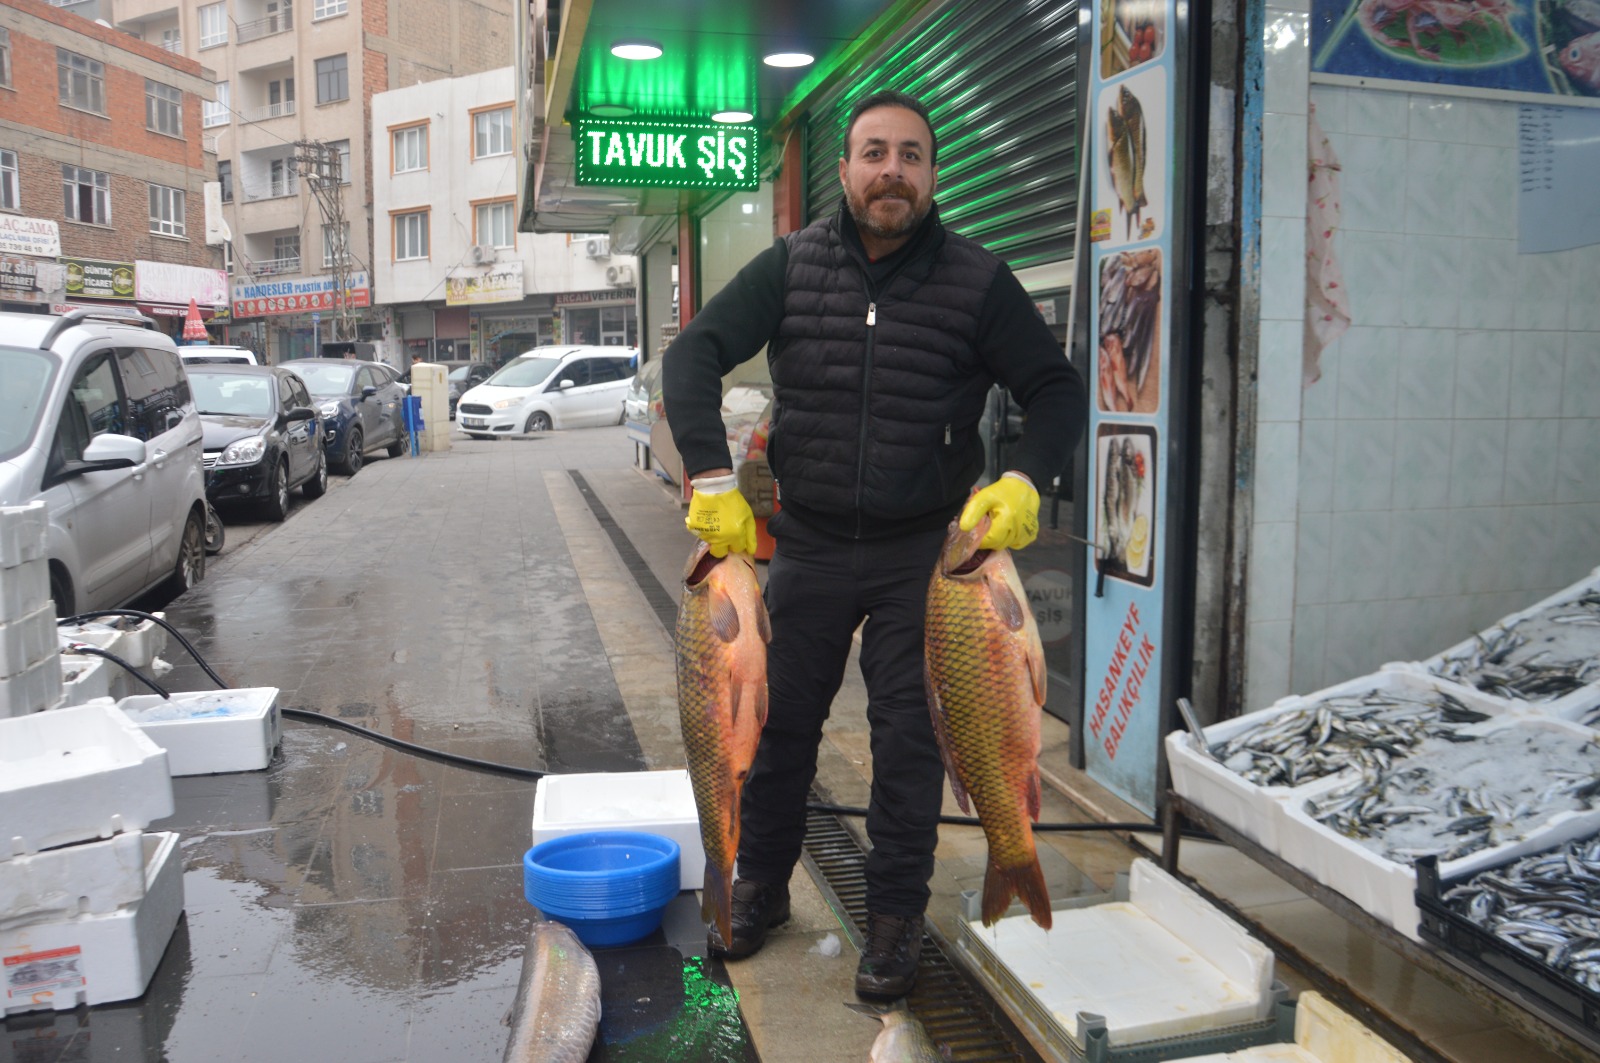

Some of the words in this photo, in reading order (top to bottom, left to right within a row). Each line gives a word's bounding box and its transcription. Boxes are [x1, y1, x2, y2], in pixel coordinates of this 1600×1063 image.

[587, 130, 687, 169] TAVUK
[697, 130, 747, 180] ŞİŞ
[84, 264, 113, 277] GÜNTAÇ
[84, 277, 113, 288] TİCARET
[294, 280, 322, 294] PLASTİK
[556, 292, 592, 304] ERCAN
[1088, 601, 1141, 740] HASANKEYF
[1103, 632, 1156, 761] BALIKÇILIK
